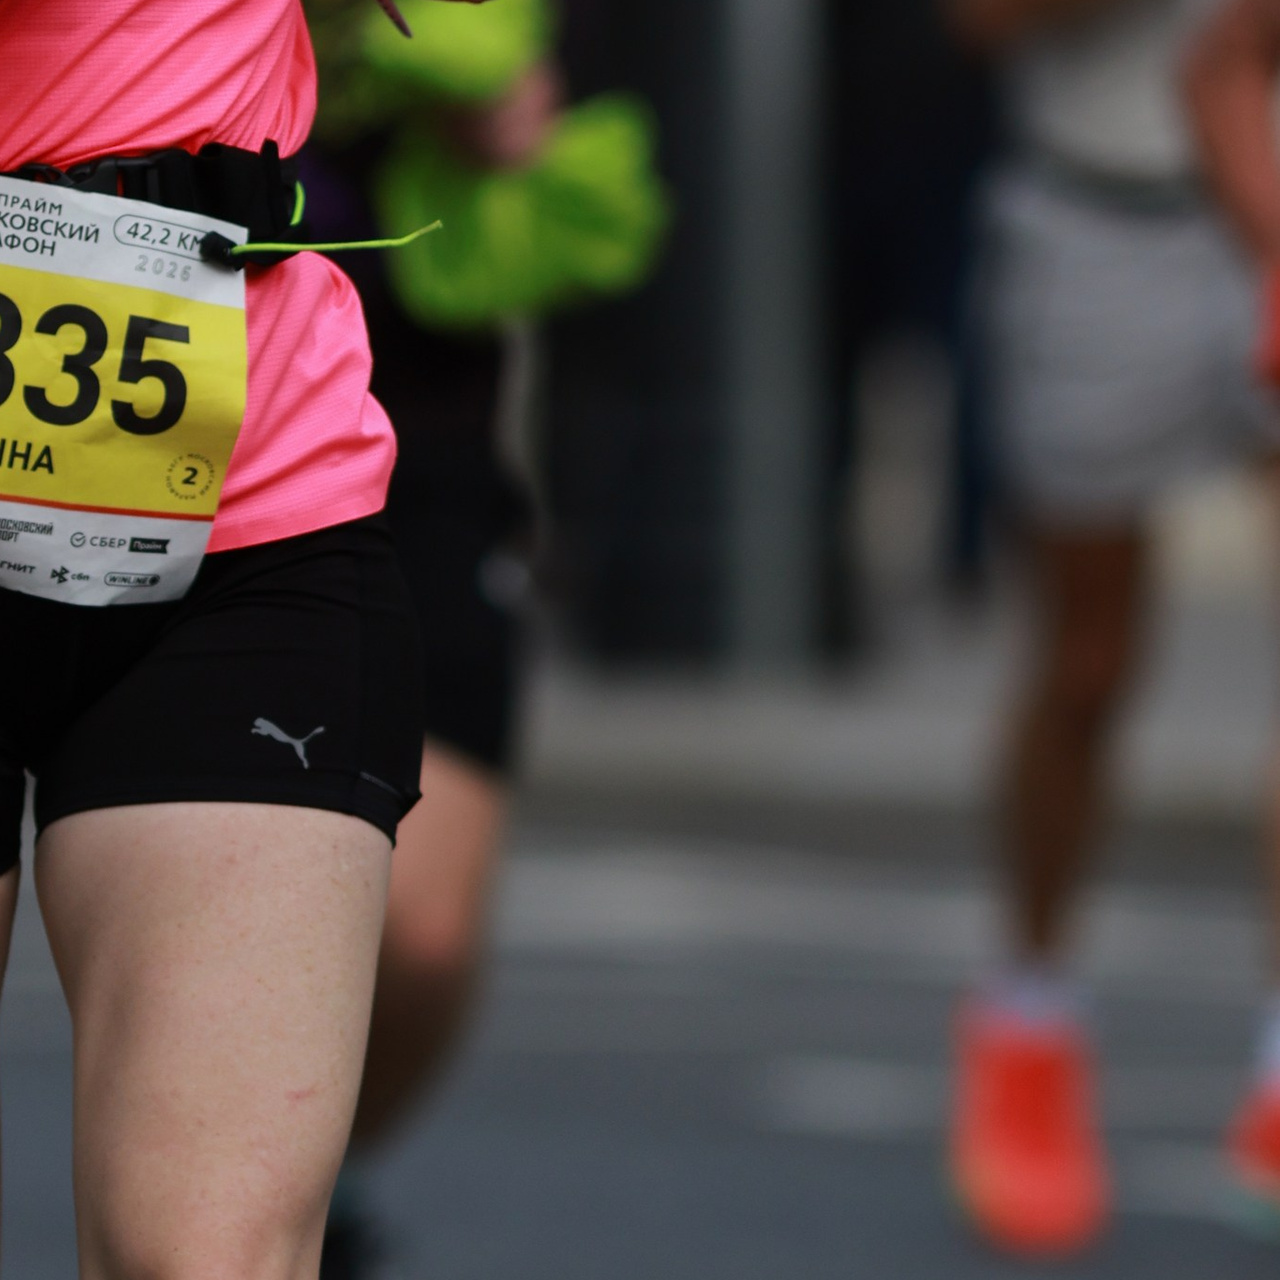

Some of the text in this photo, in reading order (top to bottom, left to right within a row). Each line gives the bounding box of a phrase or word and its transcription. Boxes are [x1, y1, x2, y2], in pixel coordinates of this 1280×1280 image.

[126, 222, 171, 246] 42,2
[134, 254, 192, 282] 2026
[181, 466, 199, 485] 2
[89, 536, 127, 549] СБЕР
